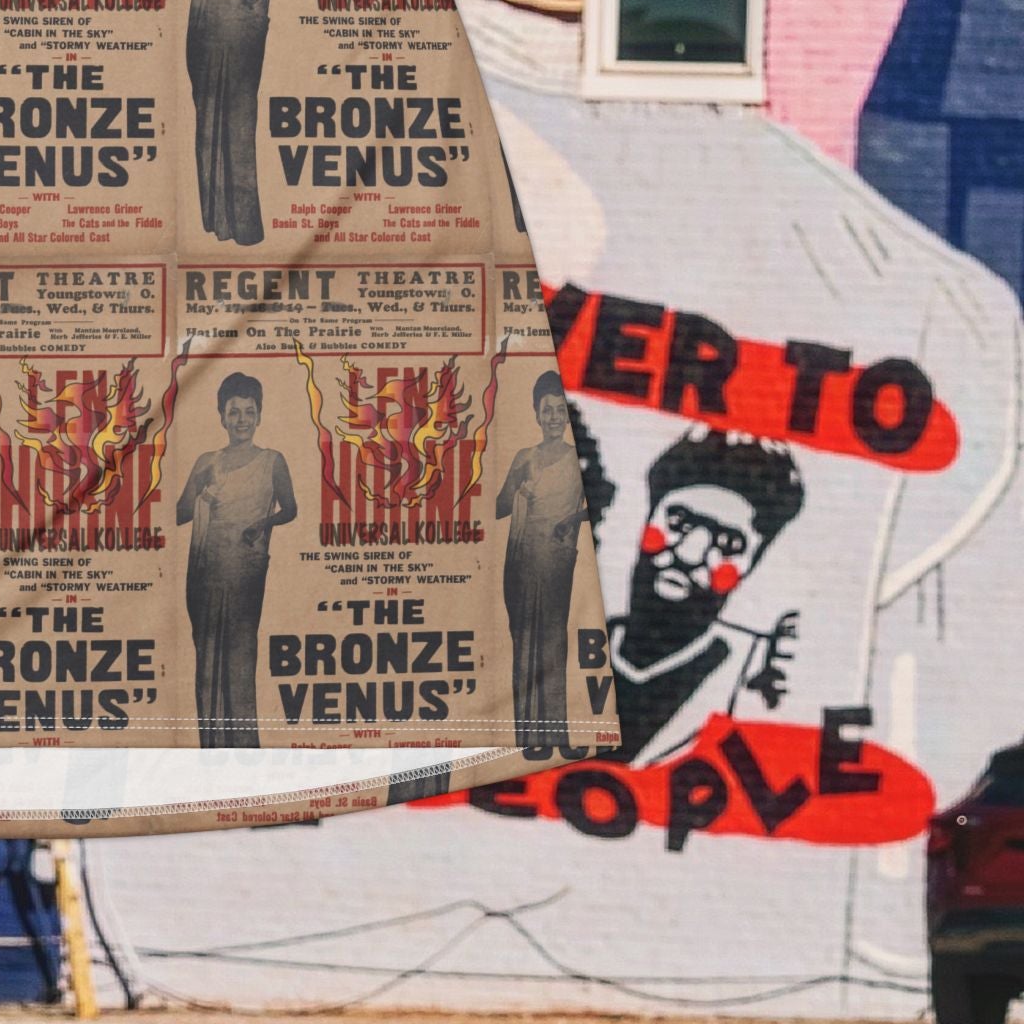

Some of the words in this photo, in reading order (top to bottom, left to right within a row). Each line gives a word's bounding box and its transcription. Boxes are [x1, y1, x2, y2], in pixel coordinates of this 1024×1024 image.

[3, 16, 39, 25] SWING
[42, 17, 73, 26] SIREN
[78, 17, 92, 26] OF
[46, 29, 57, 38] IN
[62, 29, 83, 38] THE
[19, 41, 37, 50] and
[66, 53, 77, 61] IN
[269, 96, 465, 139] BRONZE
[32, 193, 60, 202] WITH
[0, 204, 31, 216] Cooper
[67, 204, 110, 214] Lawrence
[114, 204, 143, 214] Griner
[62, 219, 75, 227] The
[79, 219, 100, 228] Cats
[102, 219, 115, 228] and
[118, 219, 129, 228] the
[135, 218, 163, 228] Fiddle
[13, 233, 24, 243] All
[27, 233, 46, 243] Star
[50, 233, 85, 243] Colored
[89, 233, 110, 243] Cast
[36, 272, 155, 285] THEATRE
[185, 270, 336, 300] REGENT
[357, 271, 476, 285] THEATRE
[783, 339, 935, 455] TO
[269, 631, 476, 676] BRONZE
[468, 705, 883, 853] EOPLE
